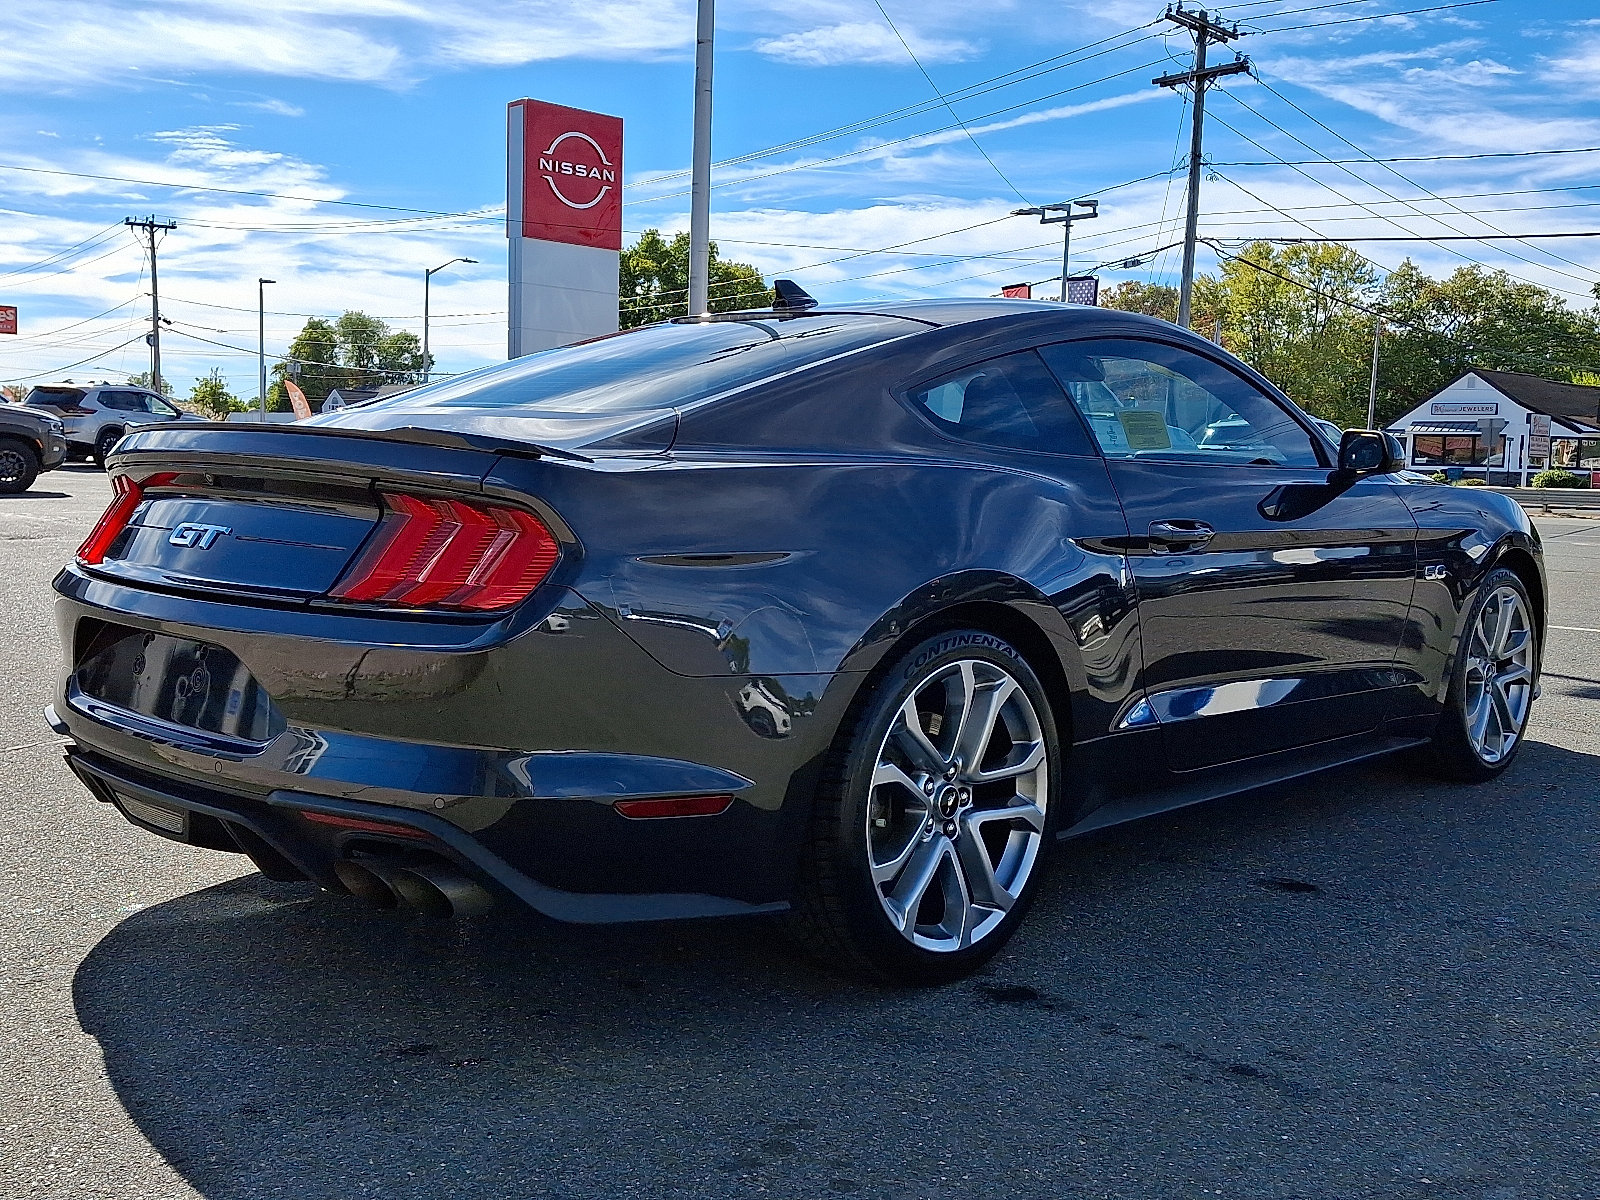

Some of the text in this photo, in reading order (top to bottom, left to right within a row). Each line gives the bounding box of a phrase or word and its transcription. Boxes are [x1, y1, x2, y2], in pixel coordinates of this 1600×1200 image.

[539, 157, 615, 182] NISSAN
[169, 522, 233, 550] GT
[903, 633, 1021, 680] CONTINENTAL
